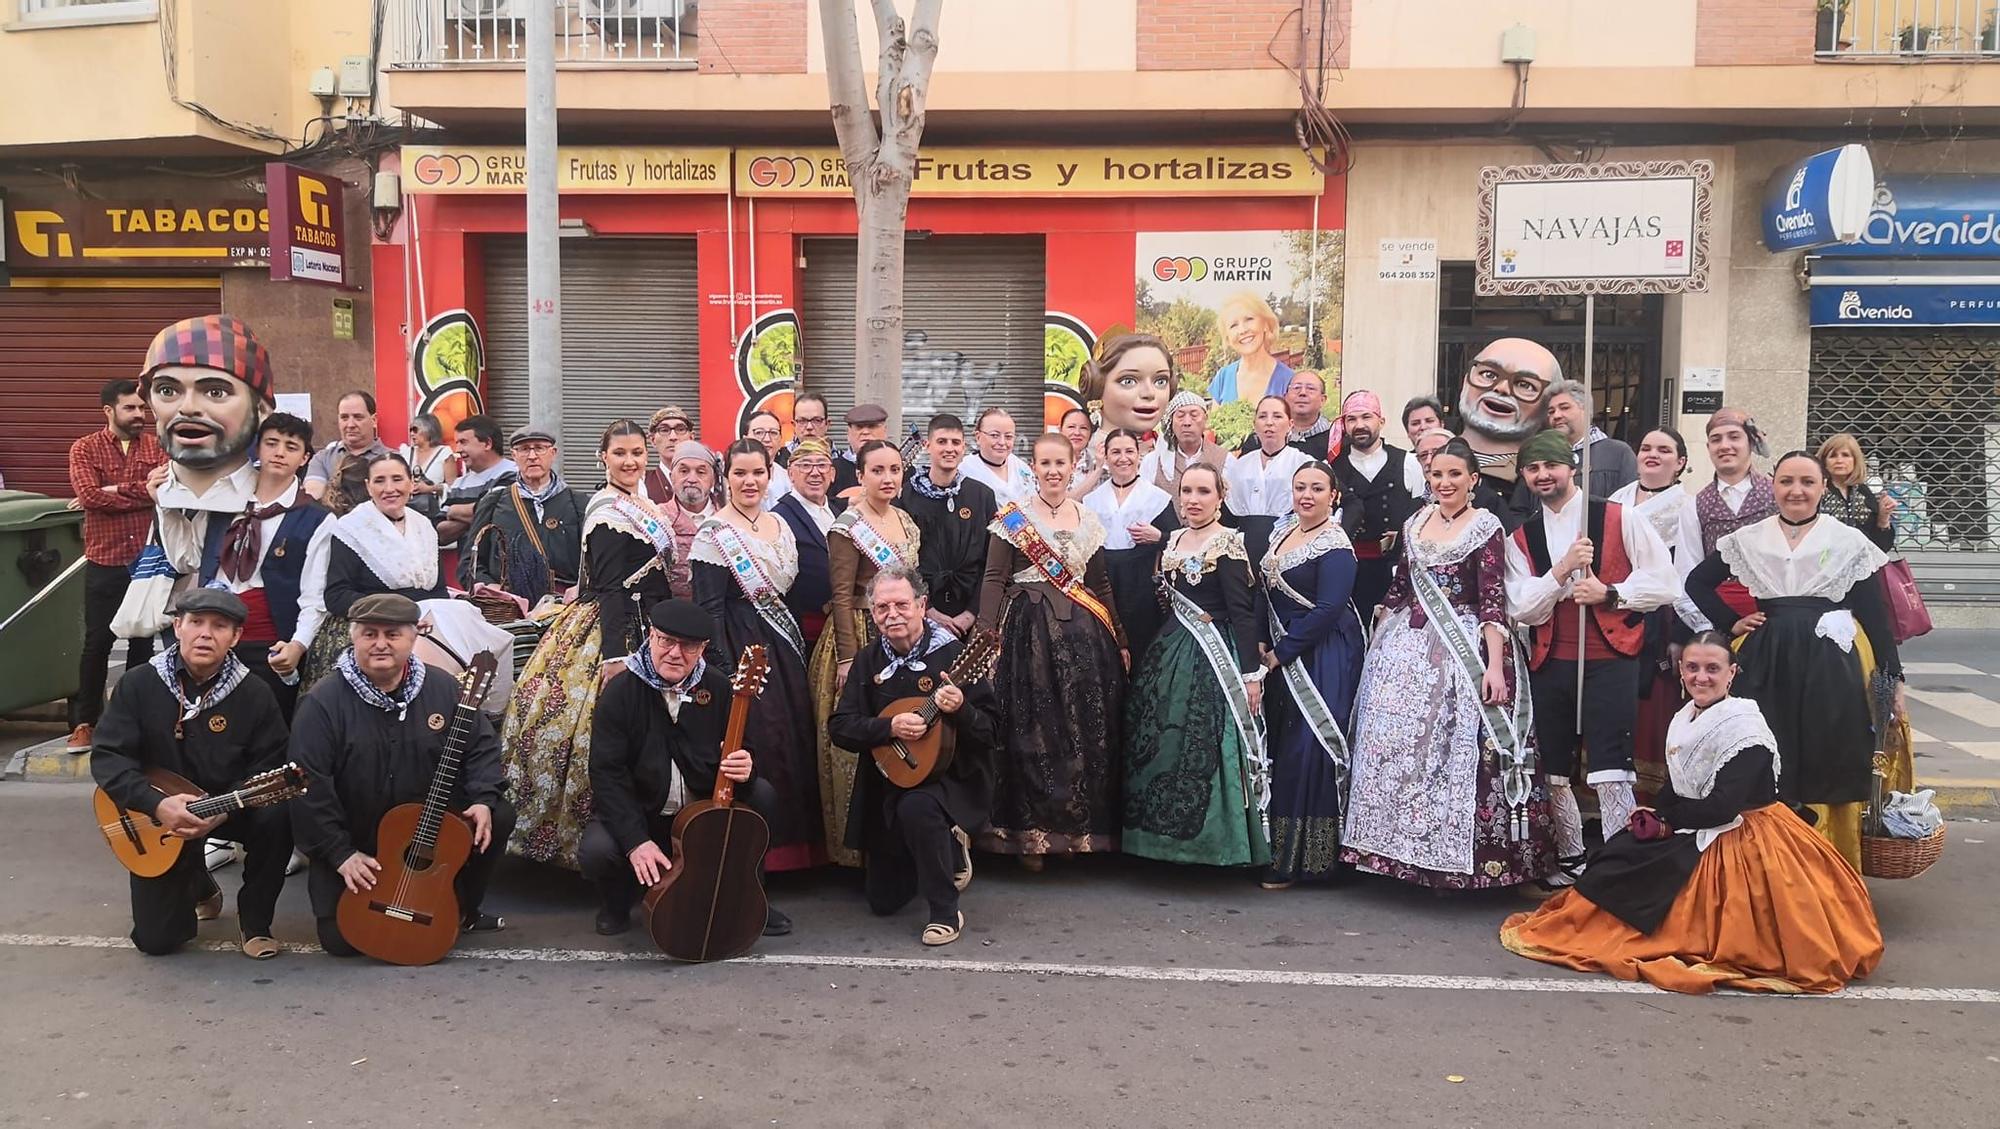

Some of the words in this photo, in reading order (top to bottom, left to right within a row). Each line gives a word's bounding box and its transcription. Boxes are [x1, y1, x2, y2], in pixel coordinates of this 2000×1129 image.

[486, 156, 525, 169] GRU
[570, 158, 617, 181] Frutas
[626, 163, 635, 187] y
[644, 158, 716, 181] hortalizas
[486, 172, 527, 185] MAR
[913, 158, 1032, 181] Frutas
[1056, 163, 1079, 186] y
[1104, 157, 1293, 180] hortalizas
[295, 225, 336, 247] TABACOS
[1522, 215, 1661, 246] NAVAJAS
[231, 247, 245, 257] EXP
[1382, 243, 1394, 251] se
[1399, 241, 1434, 251] vende
[1213, 257, 1271, 269] GRUPO
[1213, 266, 1271, 281] MARTÍN
[1379, 271, 1397, 279] 964
[1399, 271, 1417, 279] 208
[1419, 271, 1435, 279] 352
